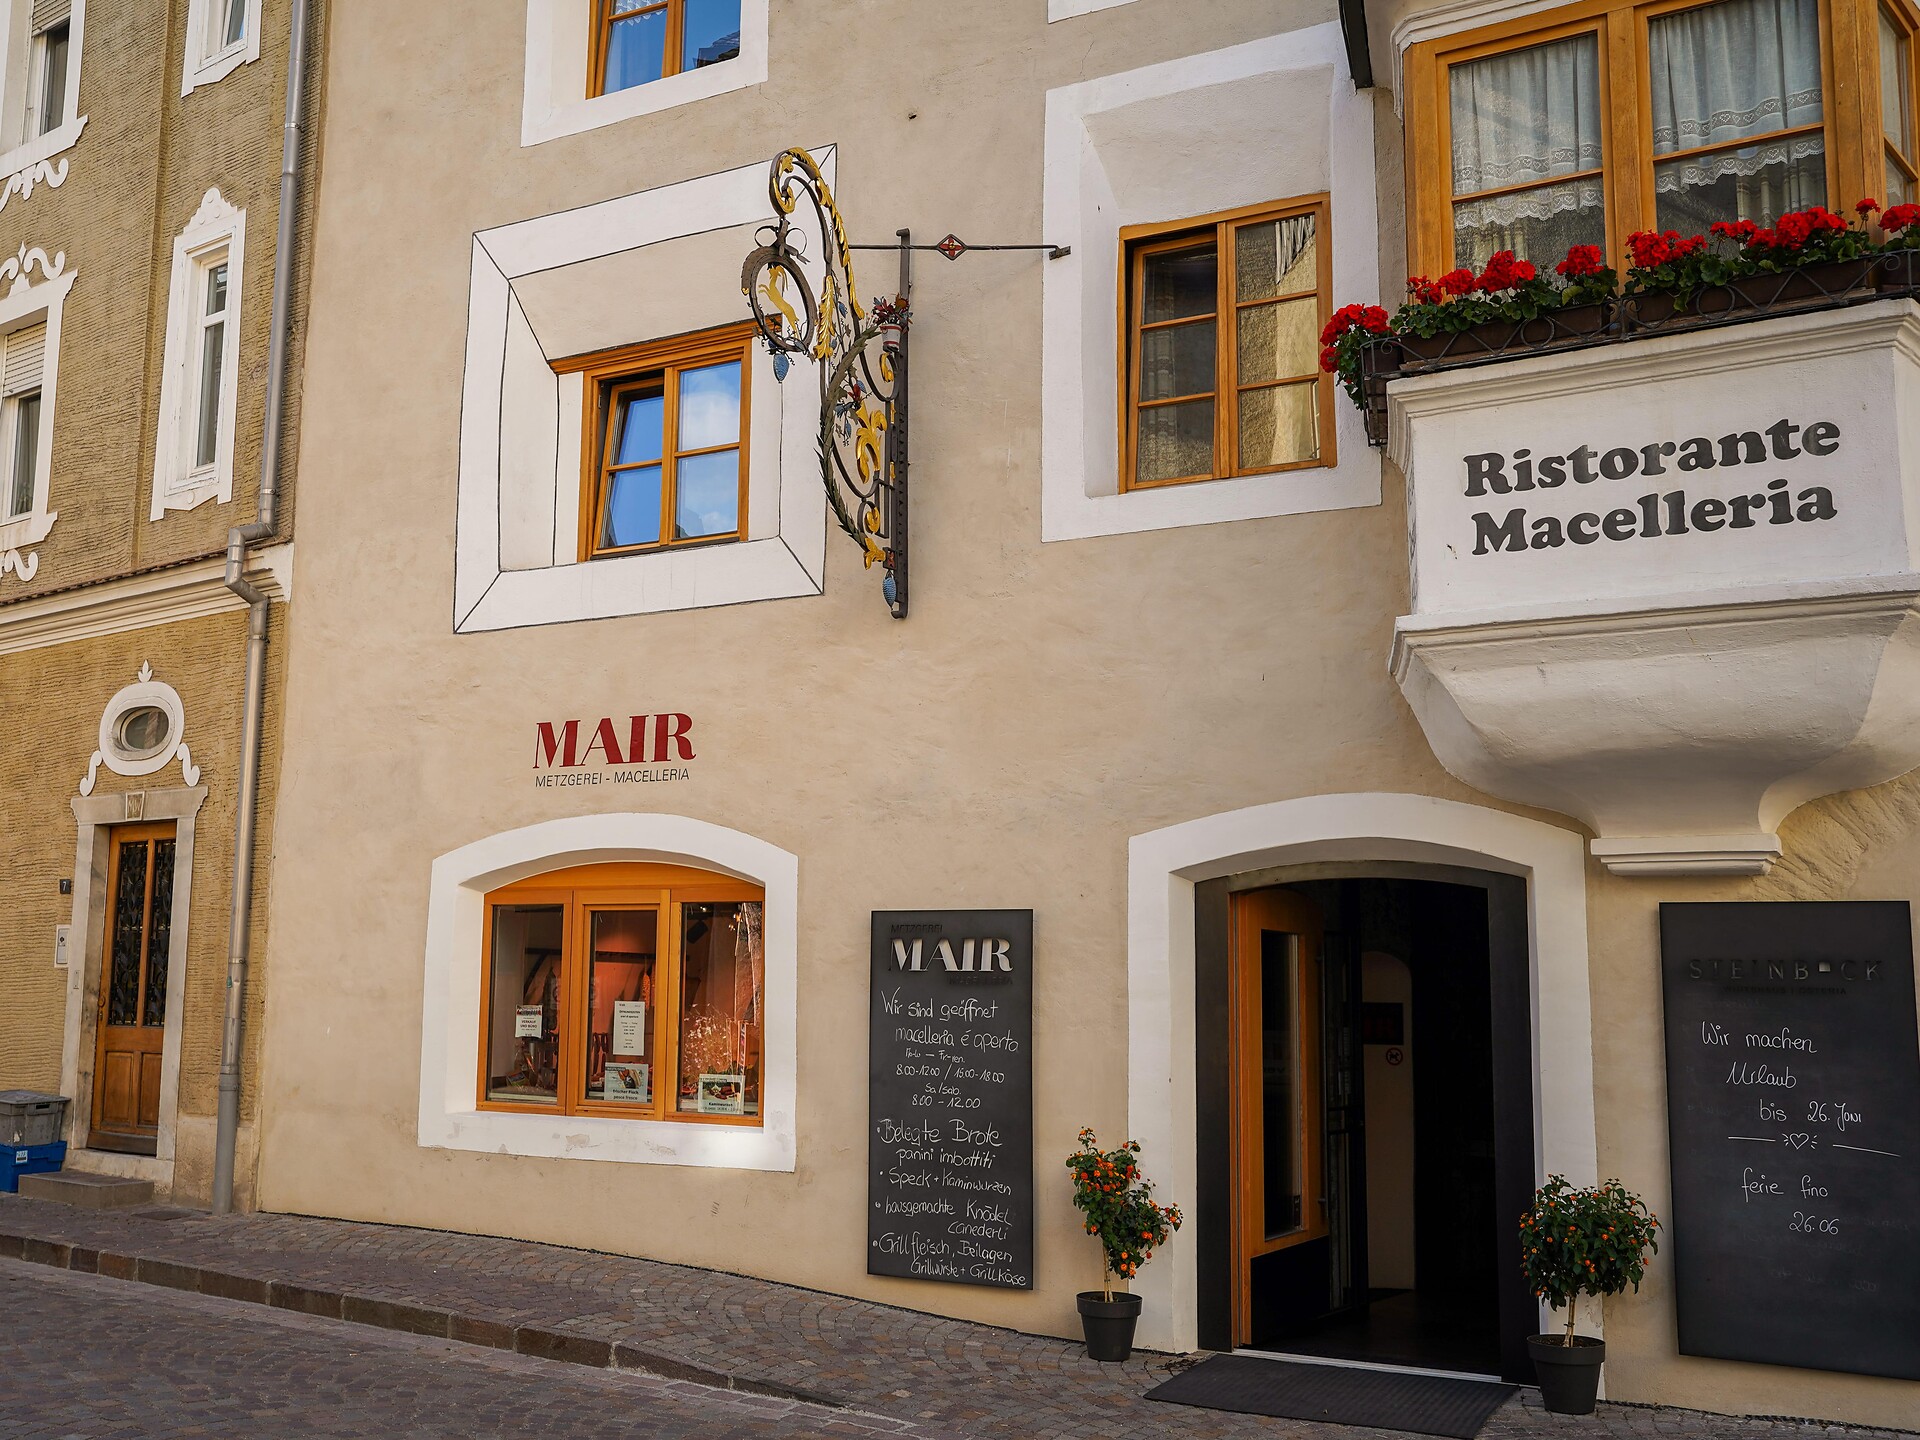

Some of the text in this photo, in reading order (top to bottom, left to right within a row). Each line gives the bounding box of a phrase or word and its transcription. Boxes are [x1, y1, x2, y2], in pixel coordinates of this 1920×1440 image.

[1463, 419, 1840, 497] Ristorante
[1472, 479, 1838, 556] Macelleria
[533, 713, 696, 768] MAIR
[536, 773, 602, 787] METZGEREI
[614, 768, 689, 783] MACELLERIA
[62, 881, 67, 891] 7
[888, 938, 1013, 971] MAIR
[881, 986, 903, 1014] Wir
[940, 998, 998, 1022] geöffnet
[896, 1025, 954, 1046] macelleria
[974, 1030, 1018, 1052] aperto
[1702, 1021, 1817, 1053] Wir machen
[1726, 1062, 1797, 1089] Urlaub
[947, 1097, 981, 1108] 12.00
[1760, 1098, 1787, 1121] bis
[1807, 1100, 1830, 1122] 26.
[879, 1119, 1003, 1146] Belegte Brote
[896, 1148, 996, 1168] panini imbottiti
[889, 1167, 931, 1189] Speck
[1741, 1167, 1828, 1202] ferie fino
[886, 1196, 956, 1216] hausgemachte
[1789, 1211, 1839, 1235] 26.06
[957, 1240, 1012, 1264] Beilagen
